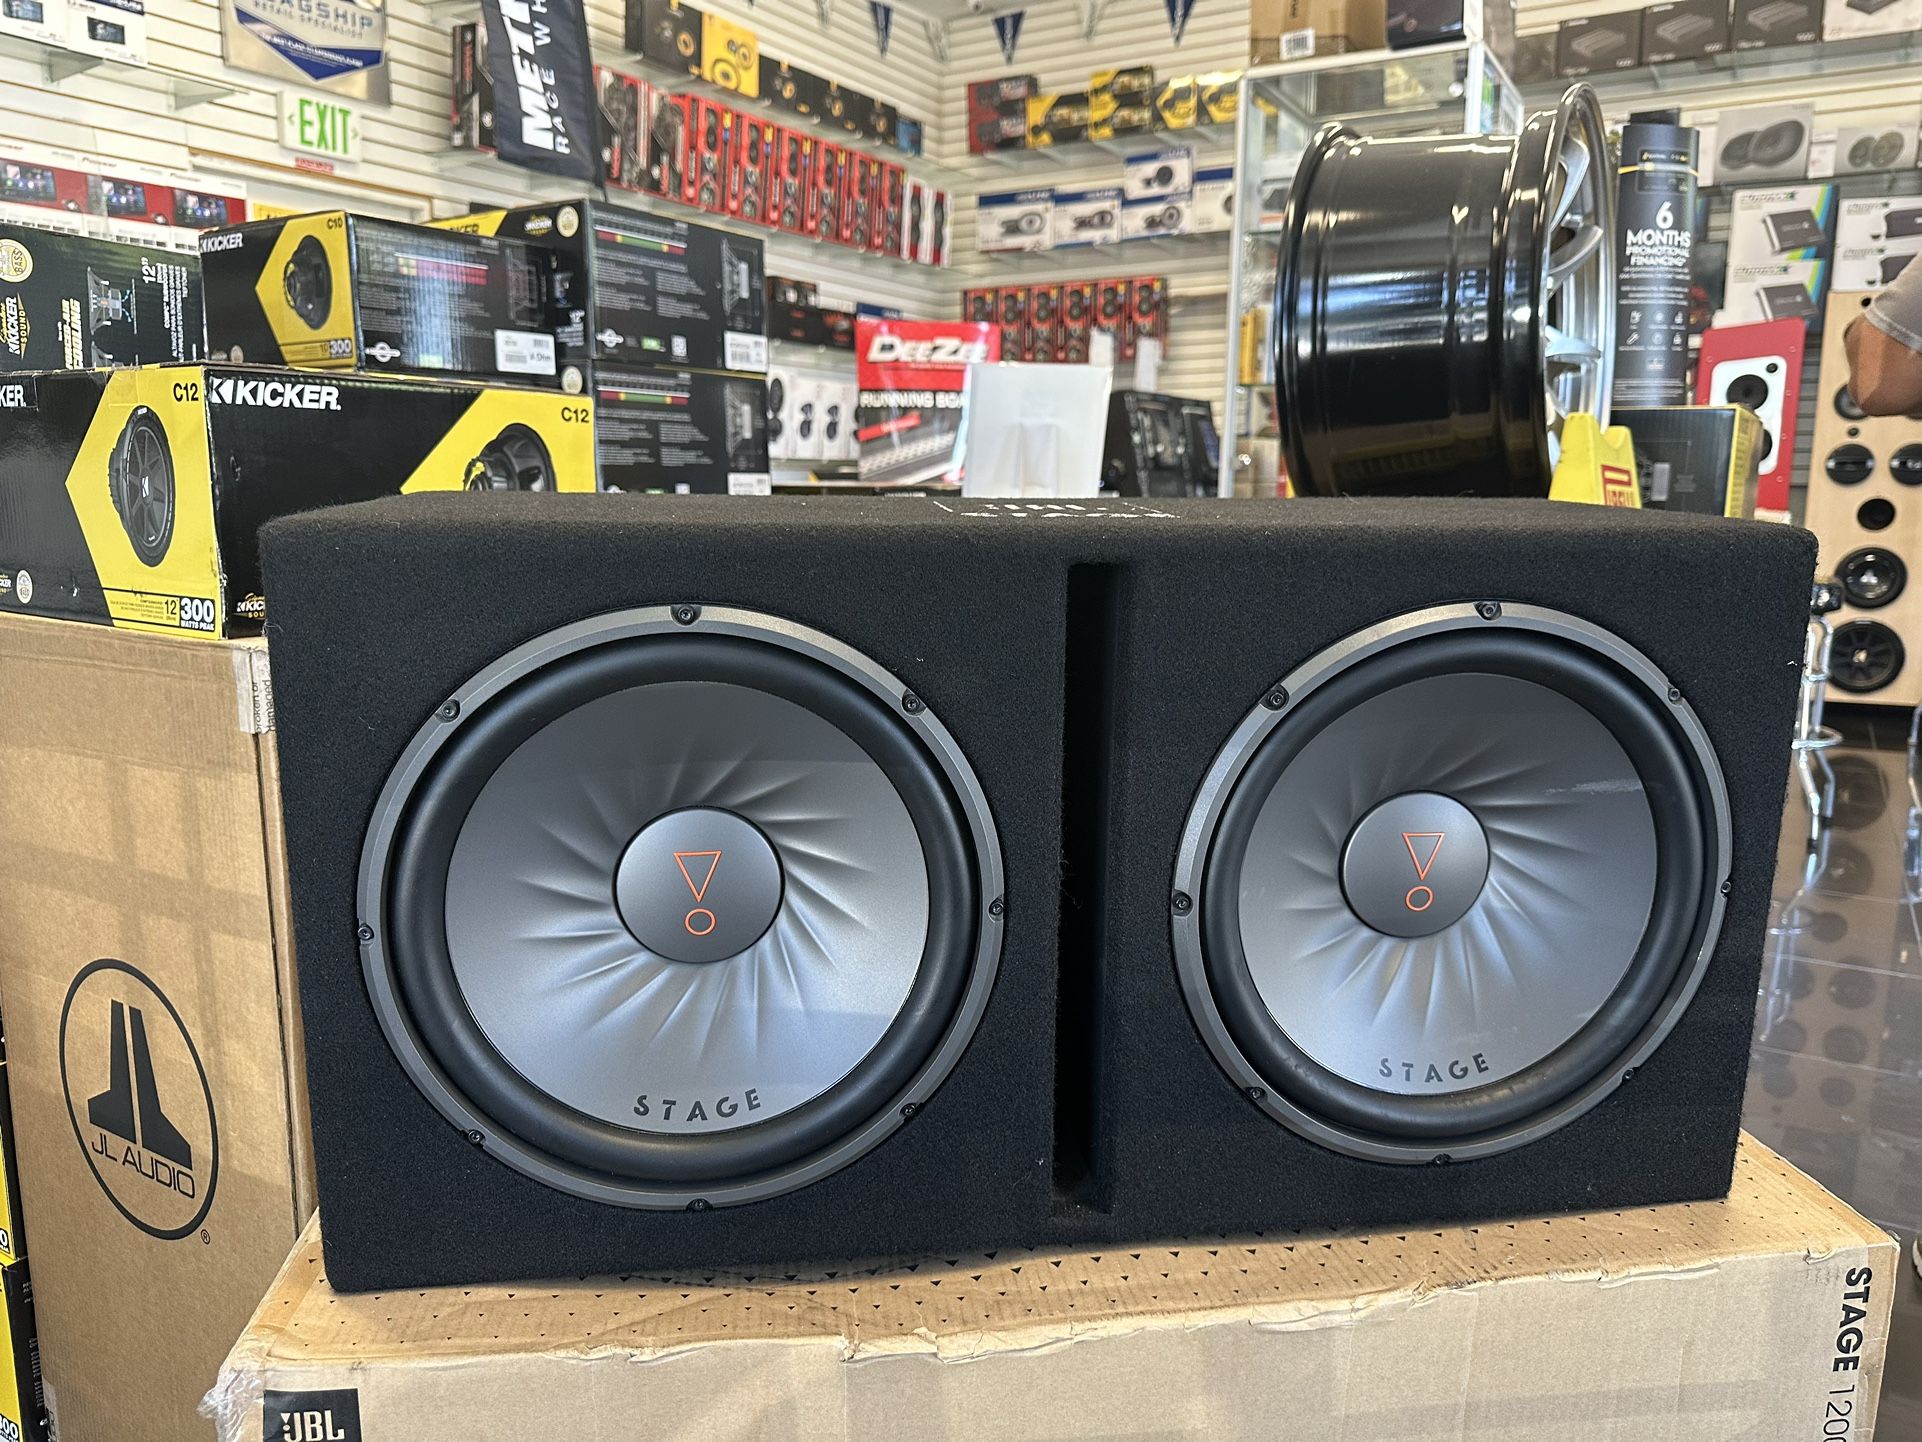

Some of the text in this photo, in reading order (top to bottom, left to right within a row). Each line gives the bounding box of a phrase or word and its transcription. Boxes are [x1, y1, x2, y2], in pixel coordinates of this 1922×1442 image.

[540, 68, 571, 154] RACE
[299, 98, 352, 155] EXIT
[326, 217, 344, 230] C10
[1656, 201, 1674, 230] 6
[207, 232, 244, 252] KICKER
[1626, 228, 1691, 248] MONTHS
[12, 247, 24, 275] BASS
[5, 297, 20, 349] KICKER
[19, 310, 28, 343] SOUND
[70, 298, 84, 370] COOLING
[330, 339, 352, 354] 300
[173, 382, 199, 402] C12
[860, 391, 935, 408] RUNNING
[561, 406, 590, 423] C12
[180, 597, 215, 623] 300
[245, 600, 265, 611] KIC
[180, 620, 215, 631] WATTS PEAK
[1379, 1052, 1490, 1083] STAGE
[633, 1087, 762, 1122] STAGE
[91, 1132, 196, 1200] JL AUDIO
[1832, 1266, 1873, 1372] STAGE
[281, 1409, 345, 1442] JBL
